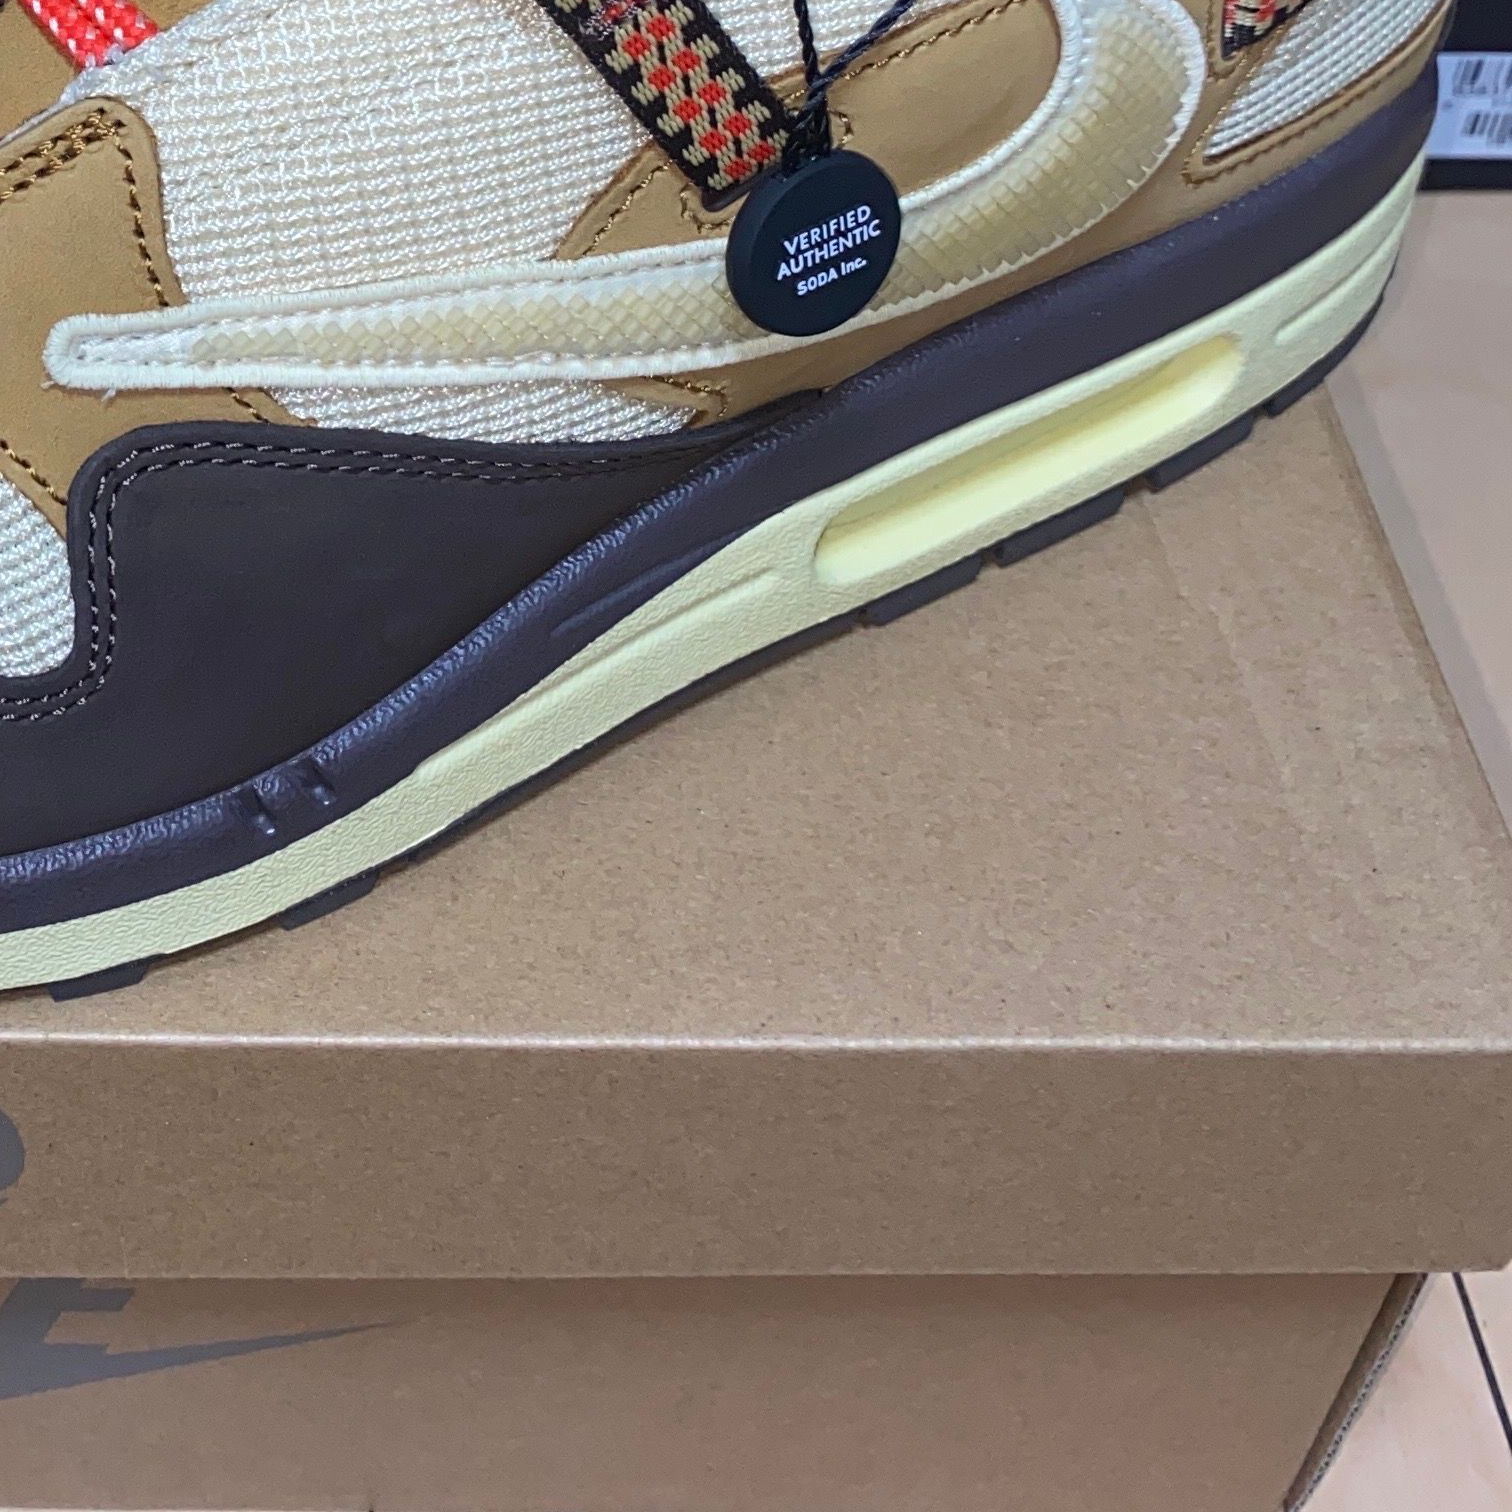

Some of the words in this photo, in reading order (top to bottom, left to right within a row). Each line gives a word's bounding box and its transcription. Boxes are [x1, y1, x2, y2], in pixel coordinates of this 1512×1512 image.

[776, 219, 882, 281] AUTHENTIC
[783, 205, 872, 256] VERIFIED
[797, 267, 839, 296] SODA
[840, 257, 868, 276] Inc.
